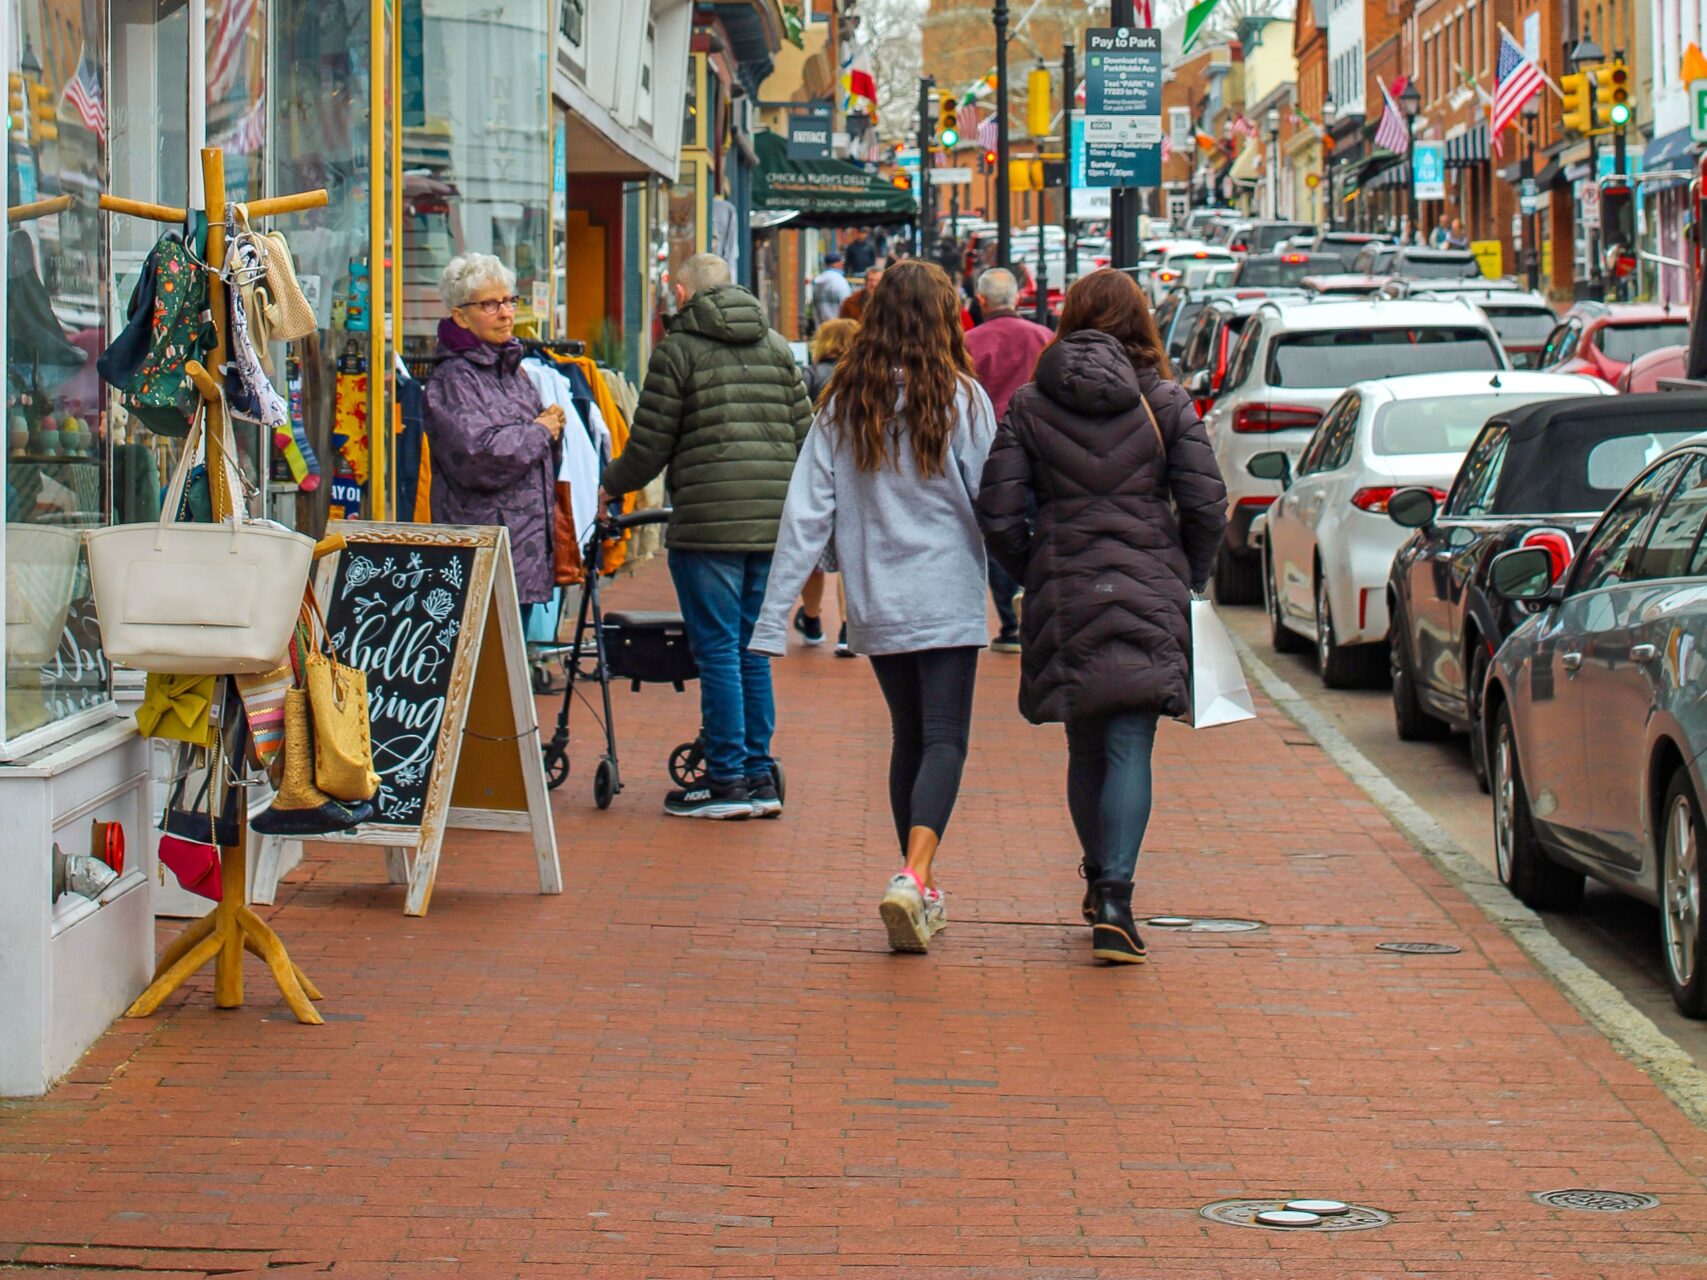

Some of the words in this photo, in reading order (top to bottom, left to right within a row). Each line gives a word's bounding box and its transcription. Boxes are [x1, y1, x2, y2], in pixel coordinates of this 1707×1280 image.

[1091, 36, 1114, 49] Pay
[1115, 37, 1128, 47] to
[1129, 36, 1156, 48] Park
[684, 788, 712, 801] HOKA
